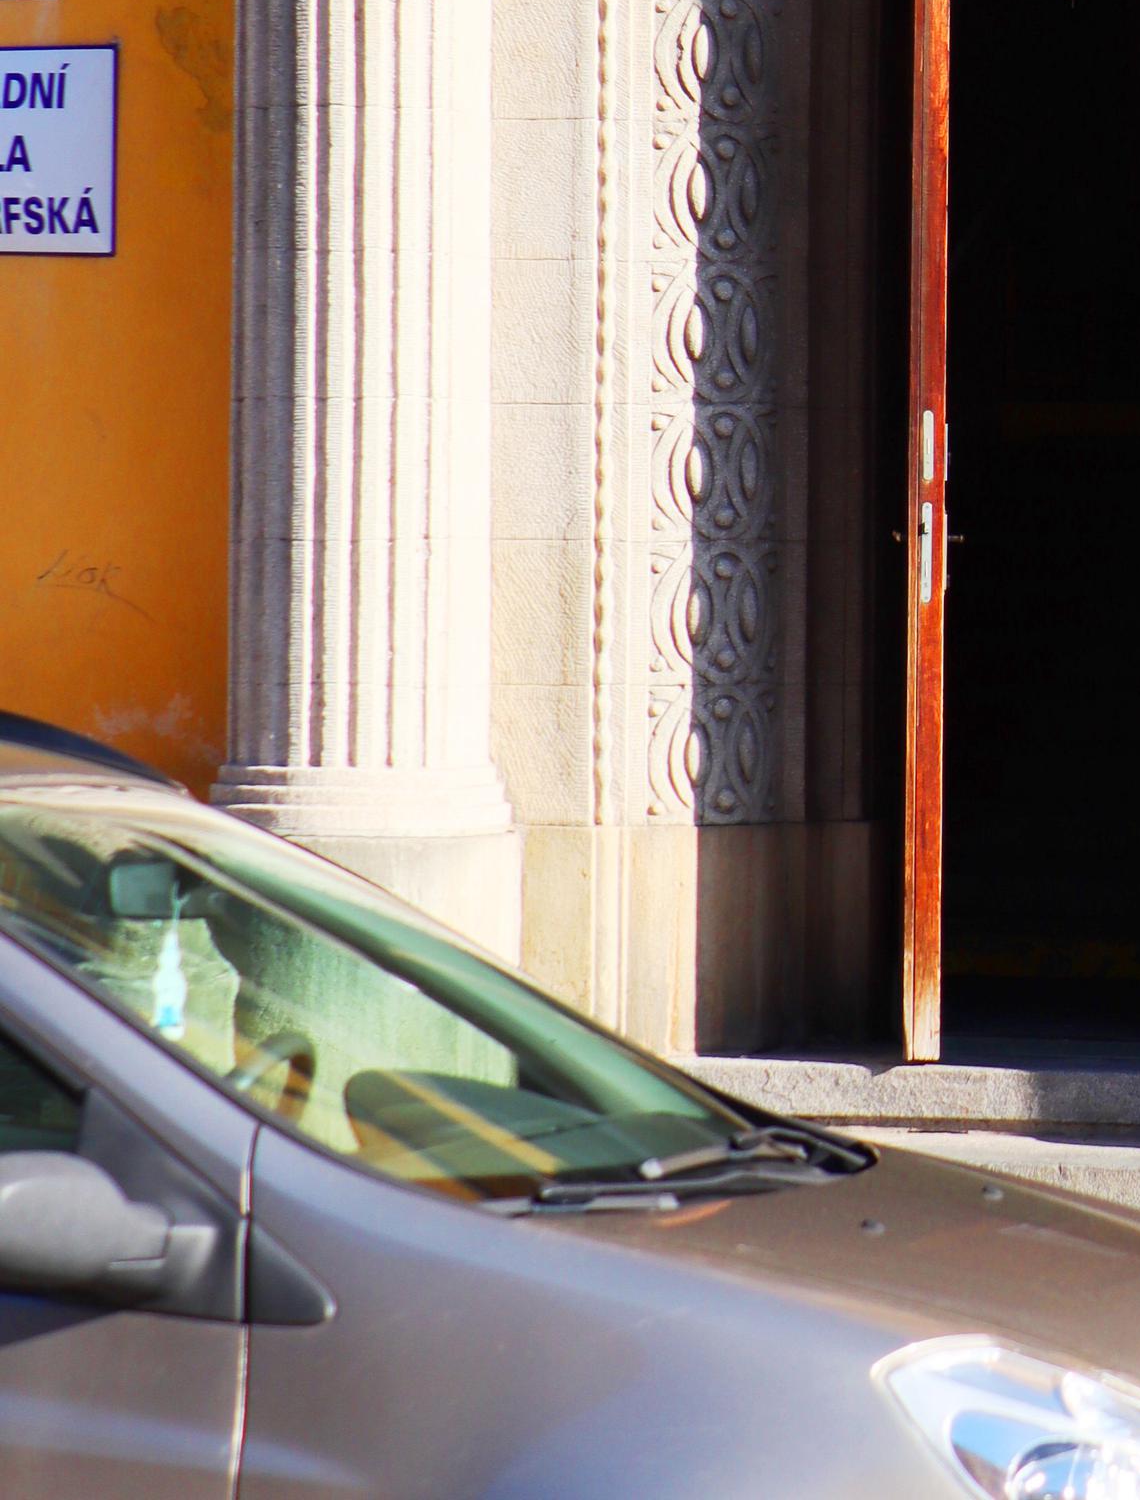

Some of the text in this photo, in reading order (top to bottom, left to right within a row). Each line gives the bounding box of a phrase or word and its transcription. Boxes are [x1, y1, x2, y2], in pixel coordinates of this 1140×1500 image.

[0, 63, 70, 109] DNÍ
[0, 135, 32, 172] A
[0, 187, 99, 234] FSKÁ
